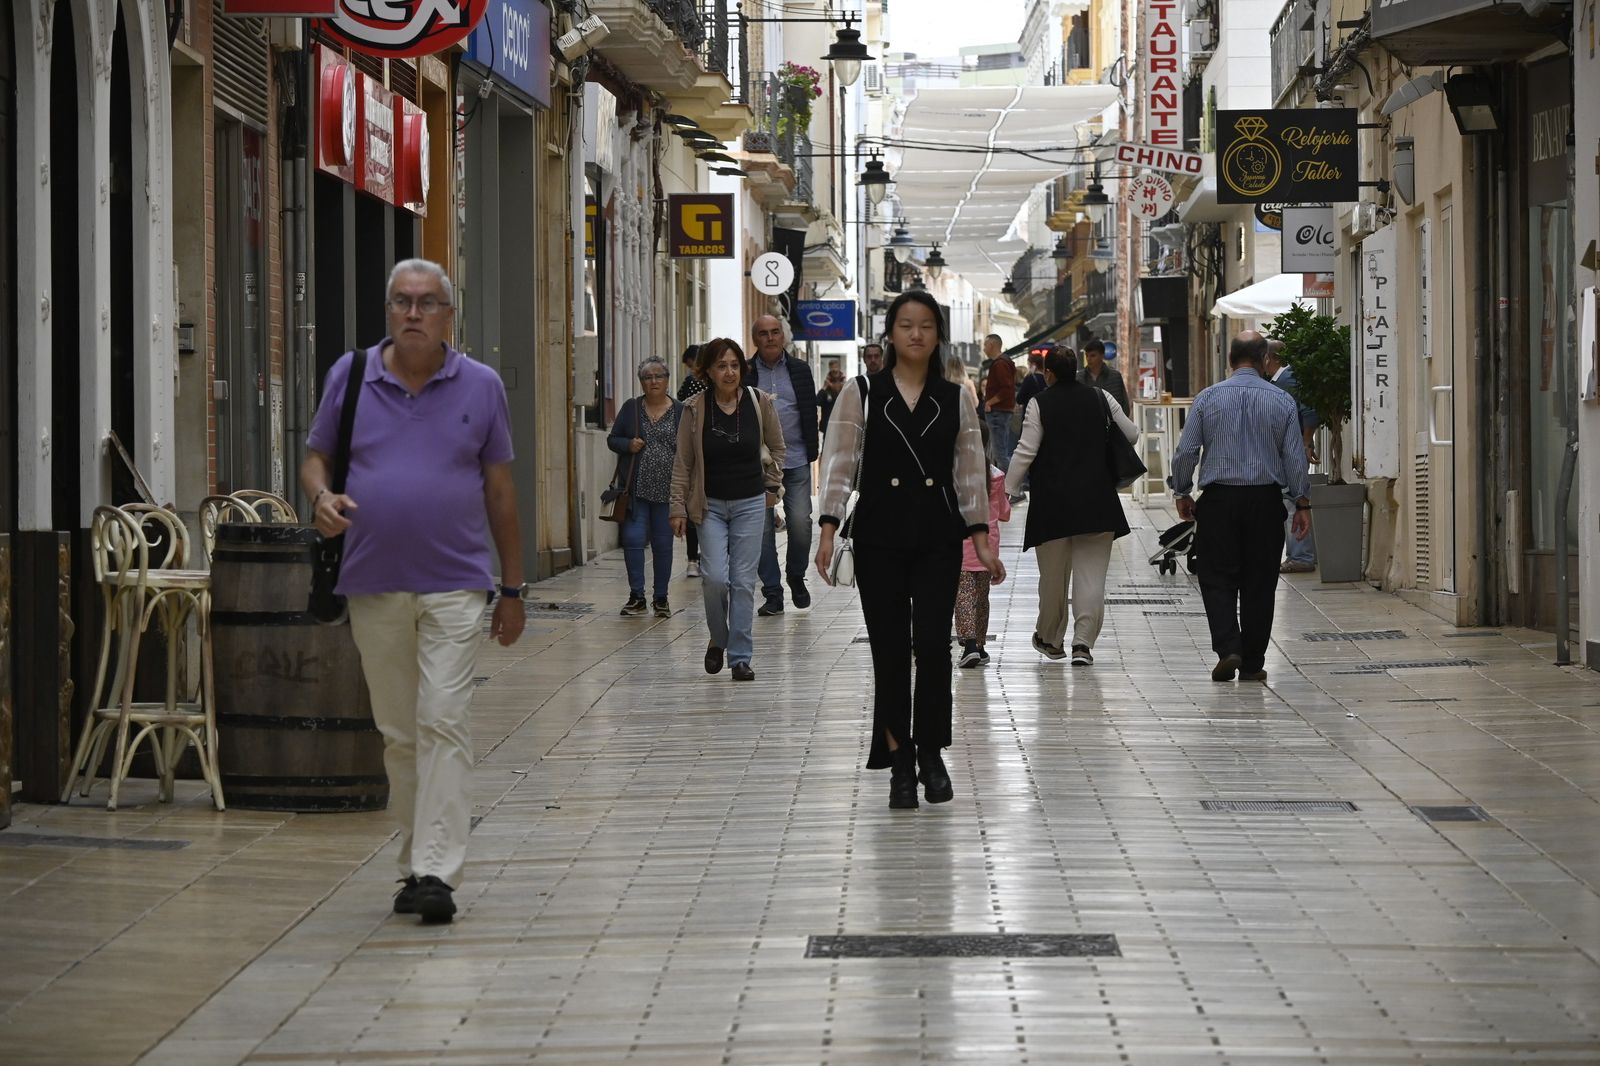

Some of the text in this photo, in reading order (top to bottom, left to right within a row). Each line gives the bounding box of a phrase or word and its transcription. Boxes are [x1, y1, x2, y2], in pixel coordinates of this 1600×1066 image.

[502, 2, 528, 78] pepco
[1150, 0, 1177, 145] TAURANTE
[1280, 126, 1352, 156] Relojería
[1118, 145, 1202, 173] CHINO
[1291, 160, 1342, 182] Taller
[1145, 175, 1172, 202] DIVINO
[679, 245, 725, 254] TABACOS
[797, 302, 846, 311] centro óptico
[1375, 276, 1389, 424] PLATERÍ
